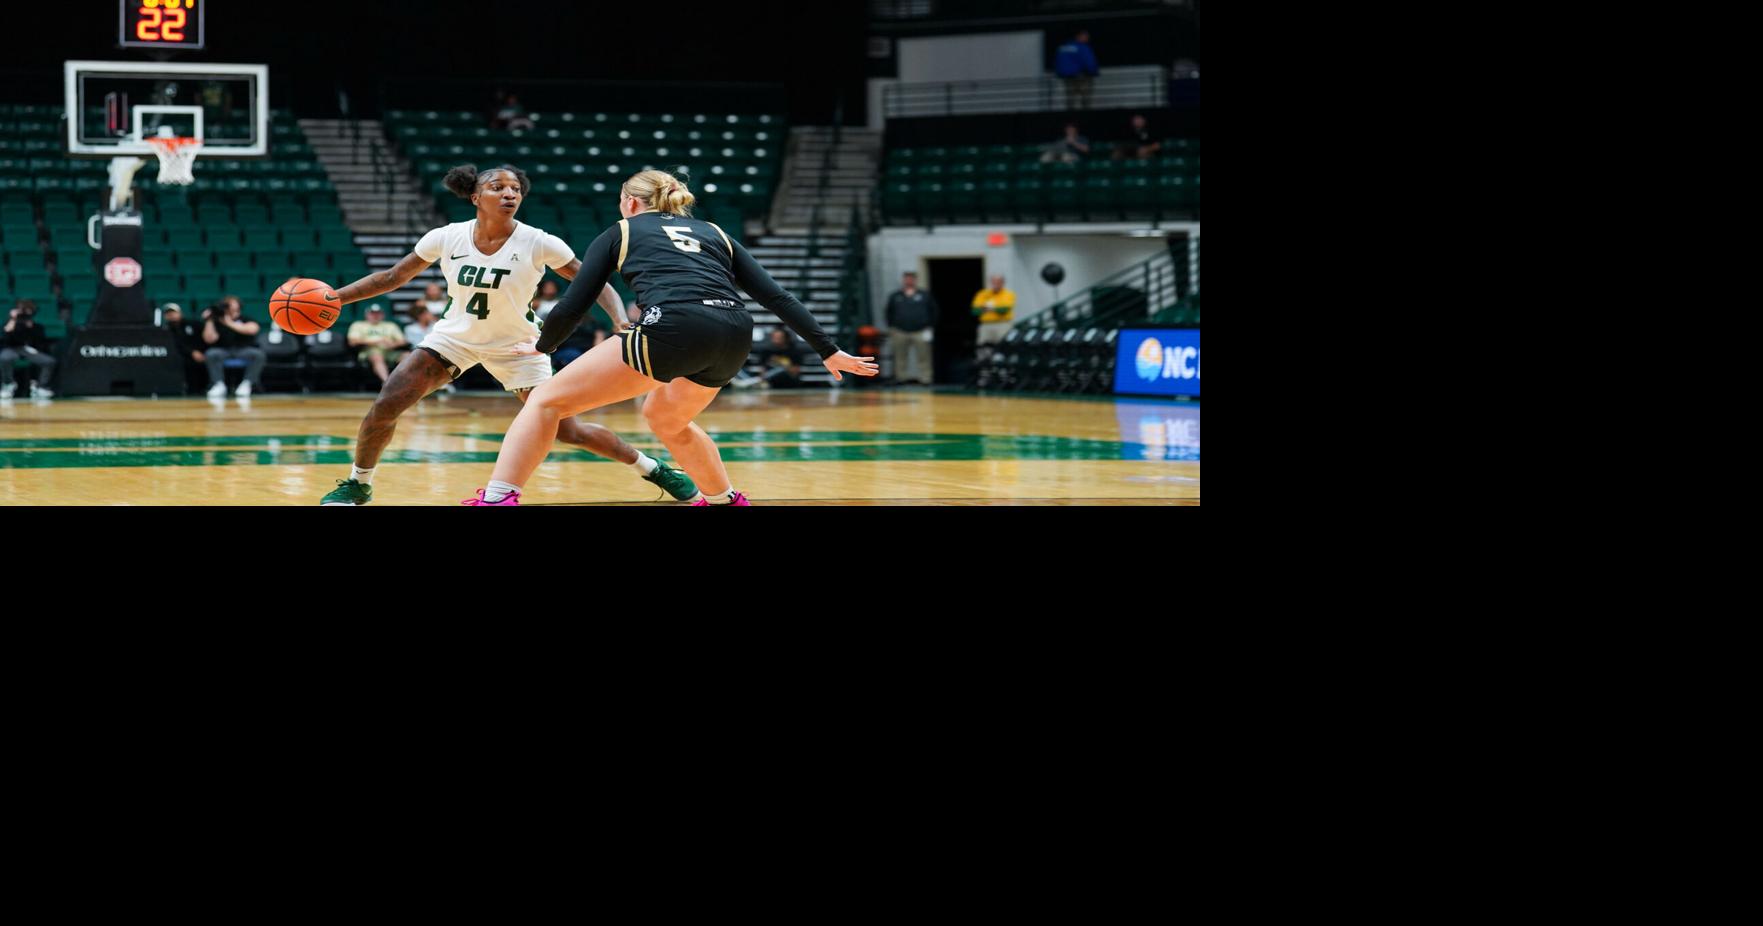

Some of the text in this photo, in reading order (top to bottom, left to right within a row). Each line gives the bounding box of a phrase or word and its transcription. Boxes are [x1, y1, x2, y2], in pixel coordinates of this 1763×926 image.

[137, 6, 187, 41] 22
[661, 225, 701, 253] 5
[466, 291, 490, 320] 4
[1161, 346, 1200, 379] NC
